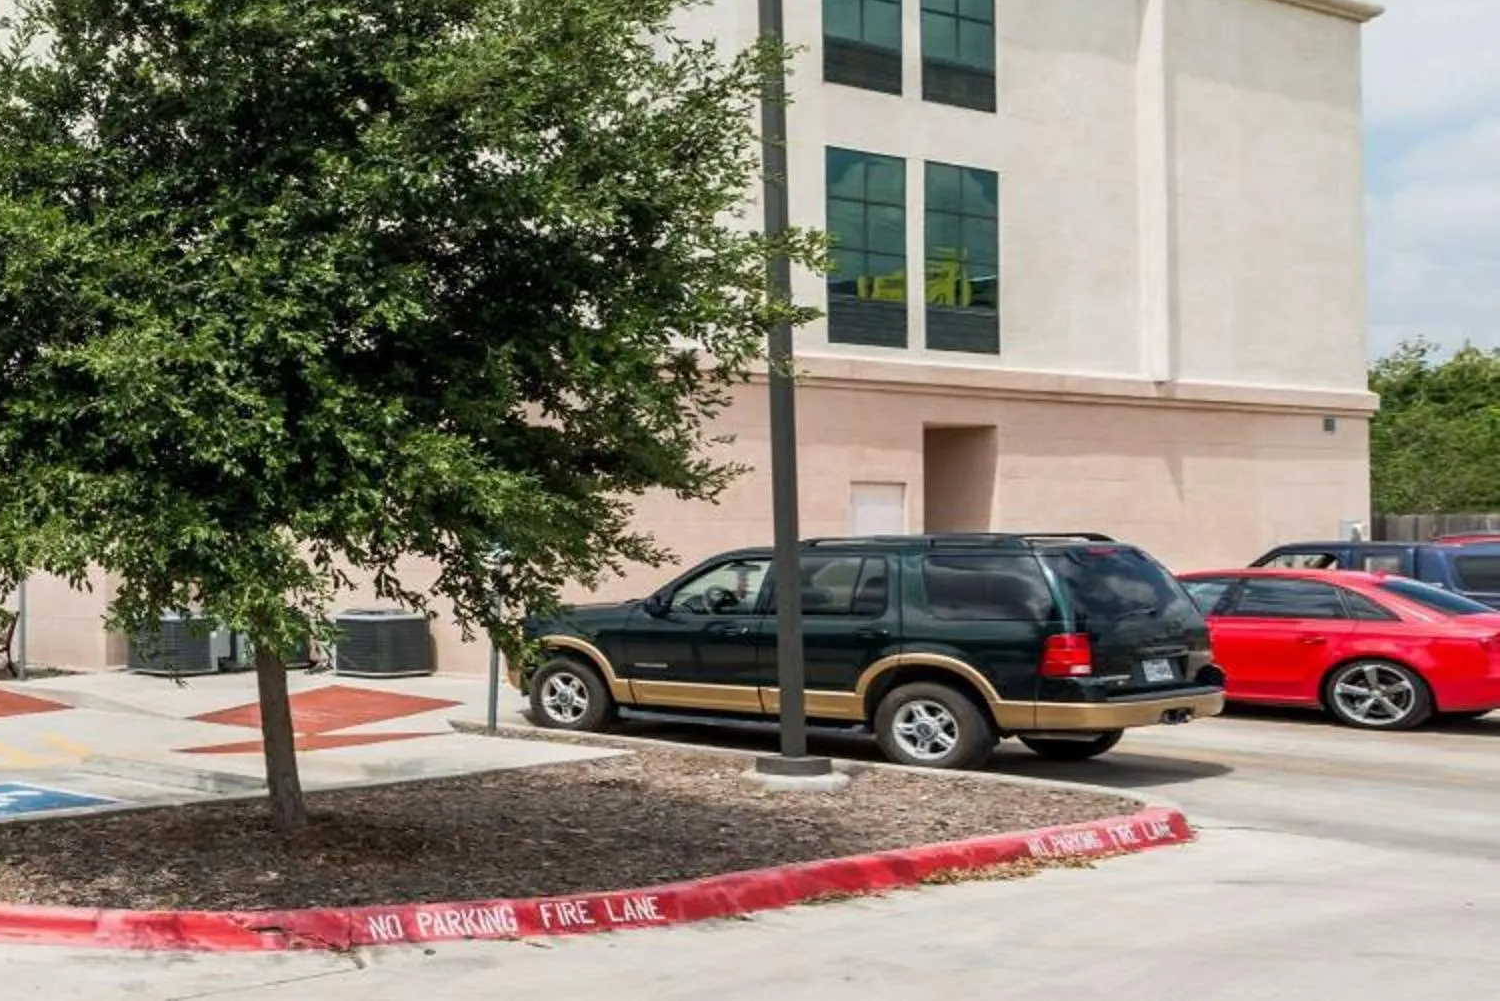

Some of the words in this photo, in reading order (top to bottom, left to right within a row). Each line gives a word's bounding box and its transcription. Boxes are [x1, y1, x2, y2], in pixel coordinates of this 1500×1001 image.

[367, 913, 405, 941] NO
[415, 906, 519, 938] PARKING
[538, 900, 596, 930] FIRE
[603, 896, 666, 923] LANE
